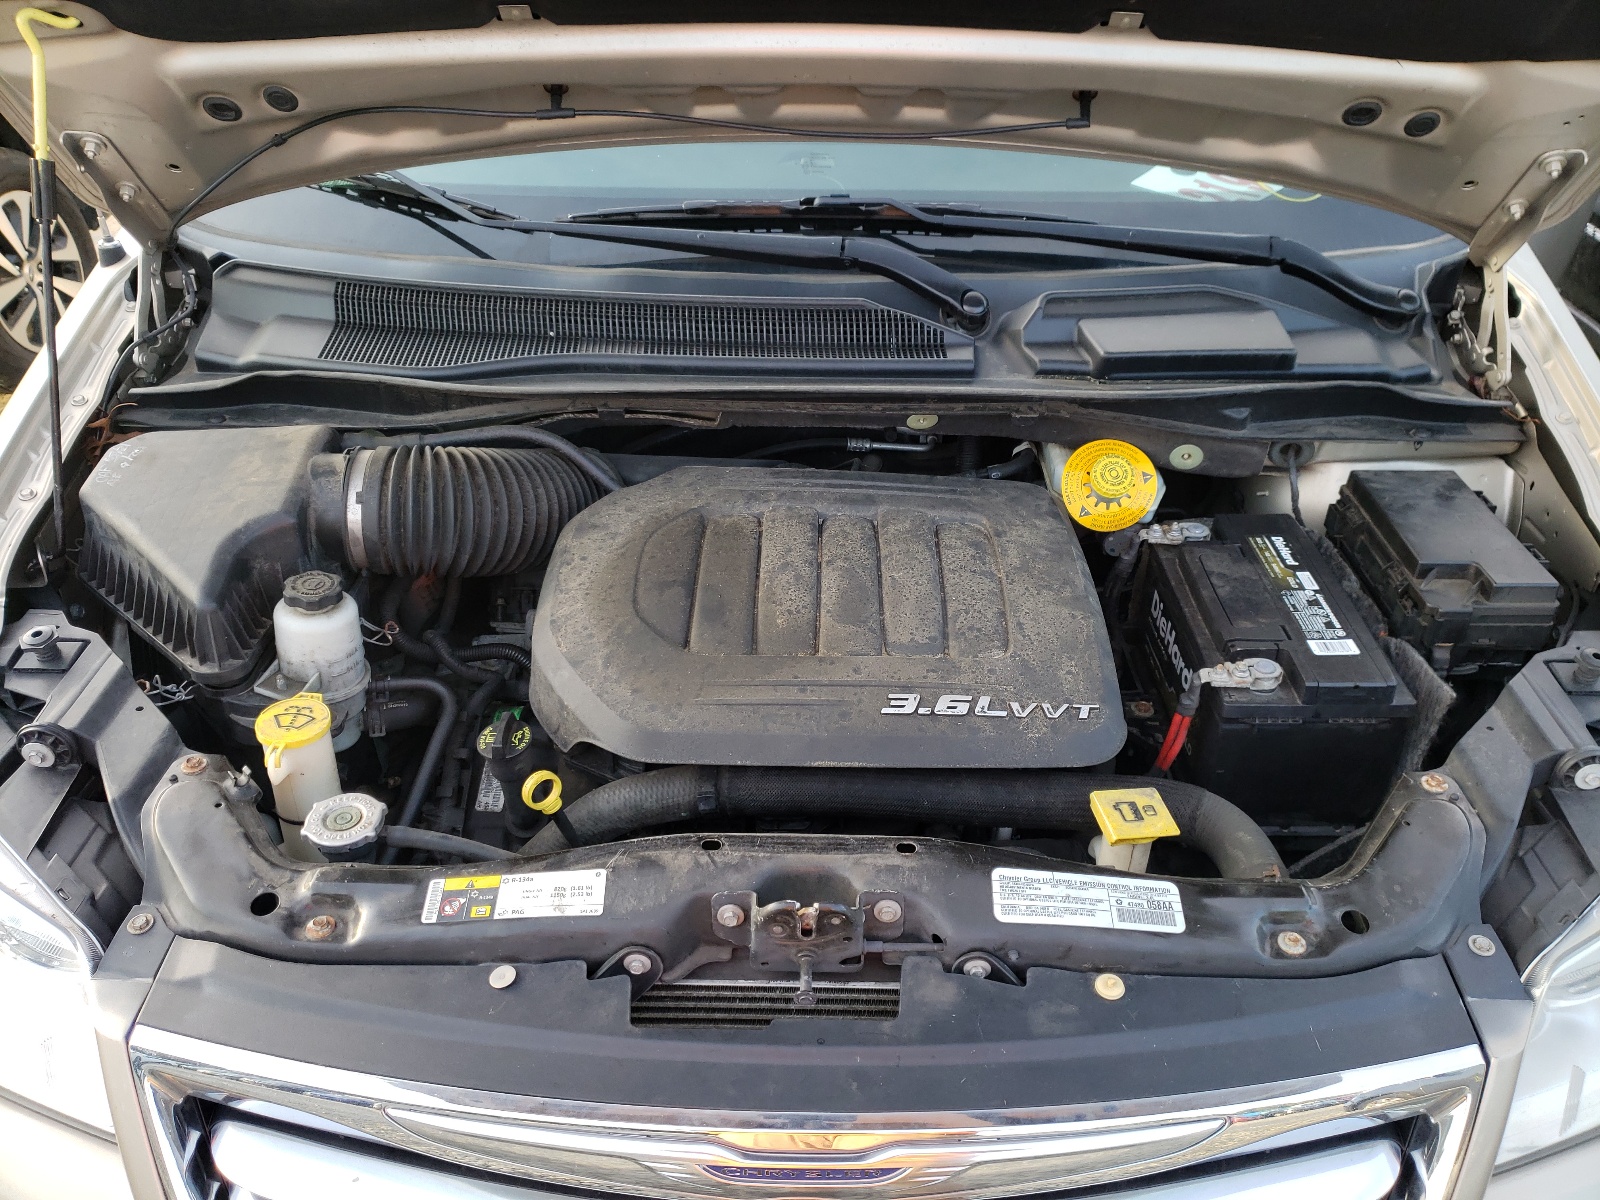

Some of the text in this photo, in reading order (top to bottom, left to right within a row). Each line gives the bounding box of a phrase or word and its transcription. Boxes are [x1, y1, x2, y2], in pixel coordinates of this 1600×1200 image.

[1270, 536, 1299, 566] DieHard
[1151, 589, 1194, 692] DieHard
[1024, 876, 1041, 884] Group
[1042, 876, 1053, 884] LLC
[1133, 885, 1171, 894] INFORMATION
[1146, 900, 1174, 911] 058AA
[721, 1167, 883, 1178] CHRYSLER
